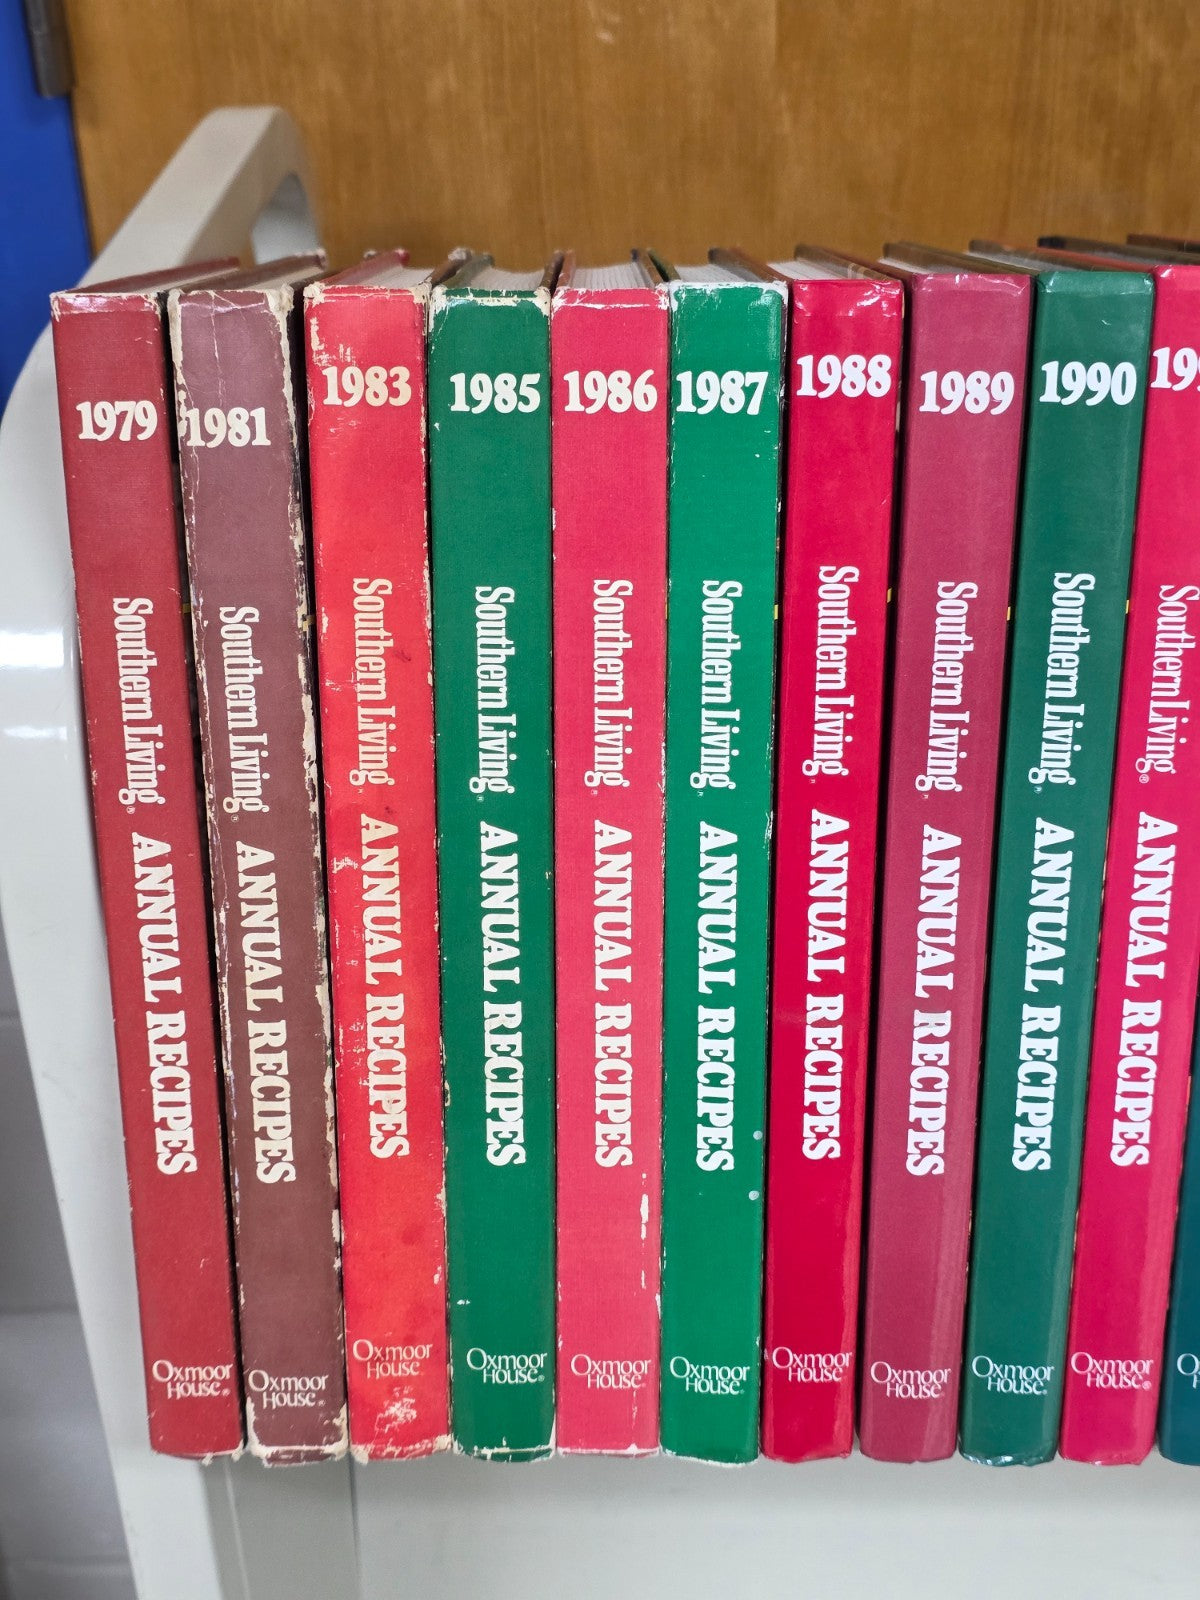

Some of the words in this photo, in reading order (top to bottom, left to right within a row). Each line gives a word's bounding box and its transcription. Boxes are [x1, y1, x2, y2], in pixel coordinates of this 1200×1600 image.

[76, 400, 157, 441] 1979
[184, 406, 271, 448] 1981
[322, 365, 411, 407] 1983
[450, 373, 540, 414] 1985
[564, 369, 657, 414] 1986
[676, 371, 768, 415] 1987
[797, 354, 891, 398] 1988
[919, 371, 1014, 415] 1989
[1040, 361, 1137, 405] 1990
[113, 598, 157, 721] Southern
[220, 607, 267, 736] Southern
[353, 578, 395, 706] Southern
[475, 586, 516, 714] Southern
[593, 580, 633, 703] Southern
[701, 580, 742, 704] Southern
[816, 566, 859, 691] Southern
[931, 582, 978, 707] Southern
[1046, 573, 1095, 698] Southern
[1150, 585, 1200, 700] Southern
[132, 832, 182, 1002] ANNUAL
[236, 841, 283, 1011] ANNUAL
[361, 814, 402, 985] ANNUAL
[480, 821, 520, 992] ANNUAL
[594, 820, 632, 991] ANNUAL
[698, 821, 737, 994] ANNUAL
[807, 809, 849, 982] ANNUAL
[915, 824, 961, 998] ANNUAL
[1025, 817, 1074, 992] ANNUAL
[1126, 812, 1177, 987] ANNUAL
[146, 1010, 197, 1174] RECIPES
[248, 1020, 296, 1183] RECIPES
[364, 993, 409, 1158] RECIPES
[484, 1001, 526, 1166] RECIPES
[595, 1003, 633, 1167] RECIPES
[696, 1005, 735, 1171] RECIPES
[802, 994, 843, 1159] RECIPES
[906, 1010, 951, 1175] RECIPES
[1012, 1004, 1061, 1171] RECIPES
[1110, 999, 1161, 1166] RECIPES
[152, 1360, 233, 1383] Oxmoor
[249, 1370, 327, 1393] Oxmoor
[353, 1339, 432, 1363] Oxmoor
[467, 1348, 547, 1370] Oxmoor
[571, 1354, 651, 1378] Oxmoor
[670, 1356, 750, 1380] Oxmoor
[772, 1347, 852, 1370] Oxmoor
[871, 1362, 951, 1388] Oxmoor
[972, 1356, 1055, 1380] Oxmoor
[1071, 1352, 1154, 1380] Oxmoor
